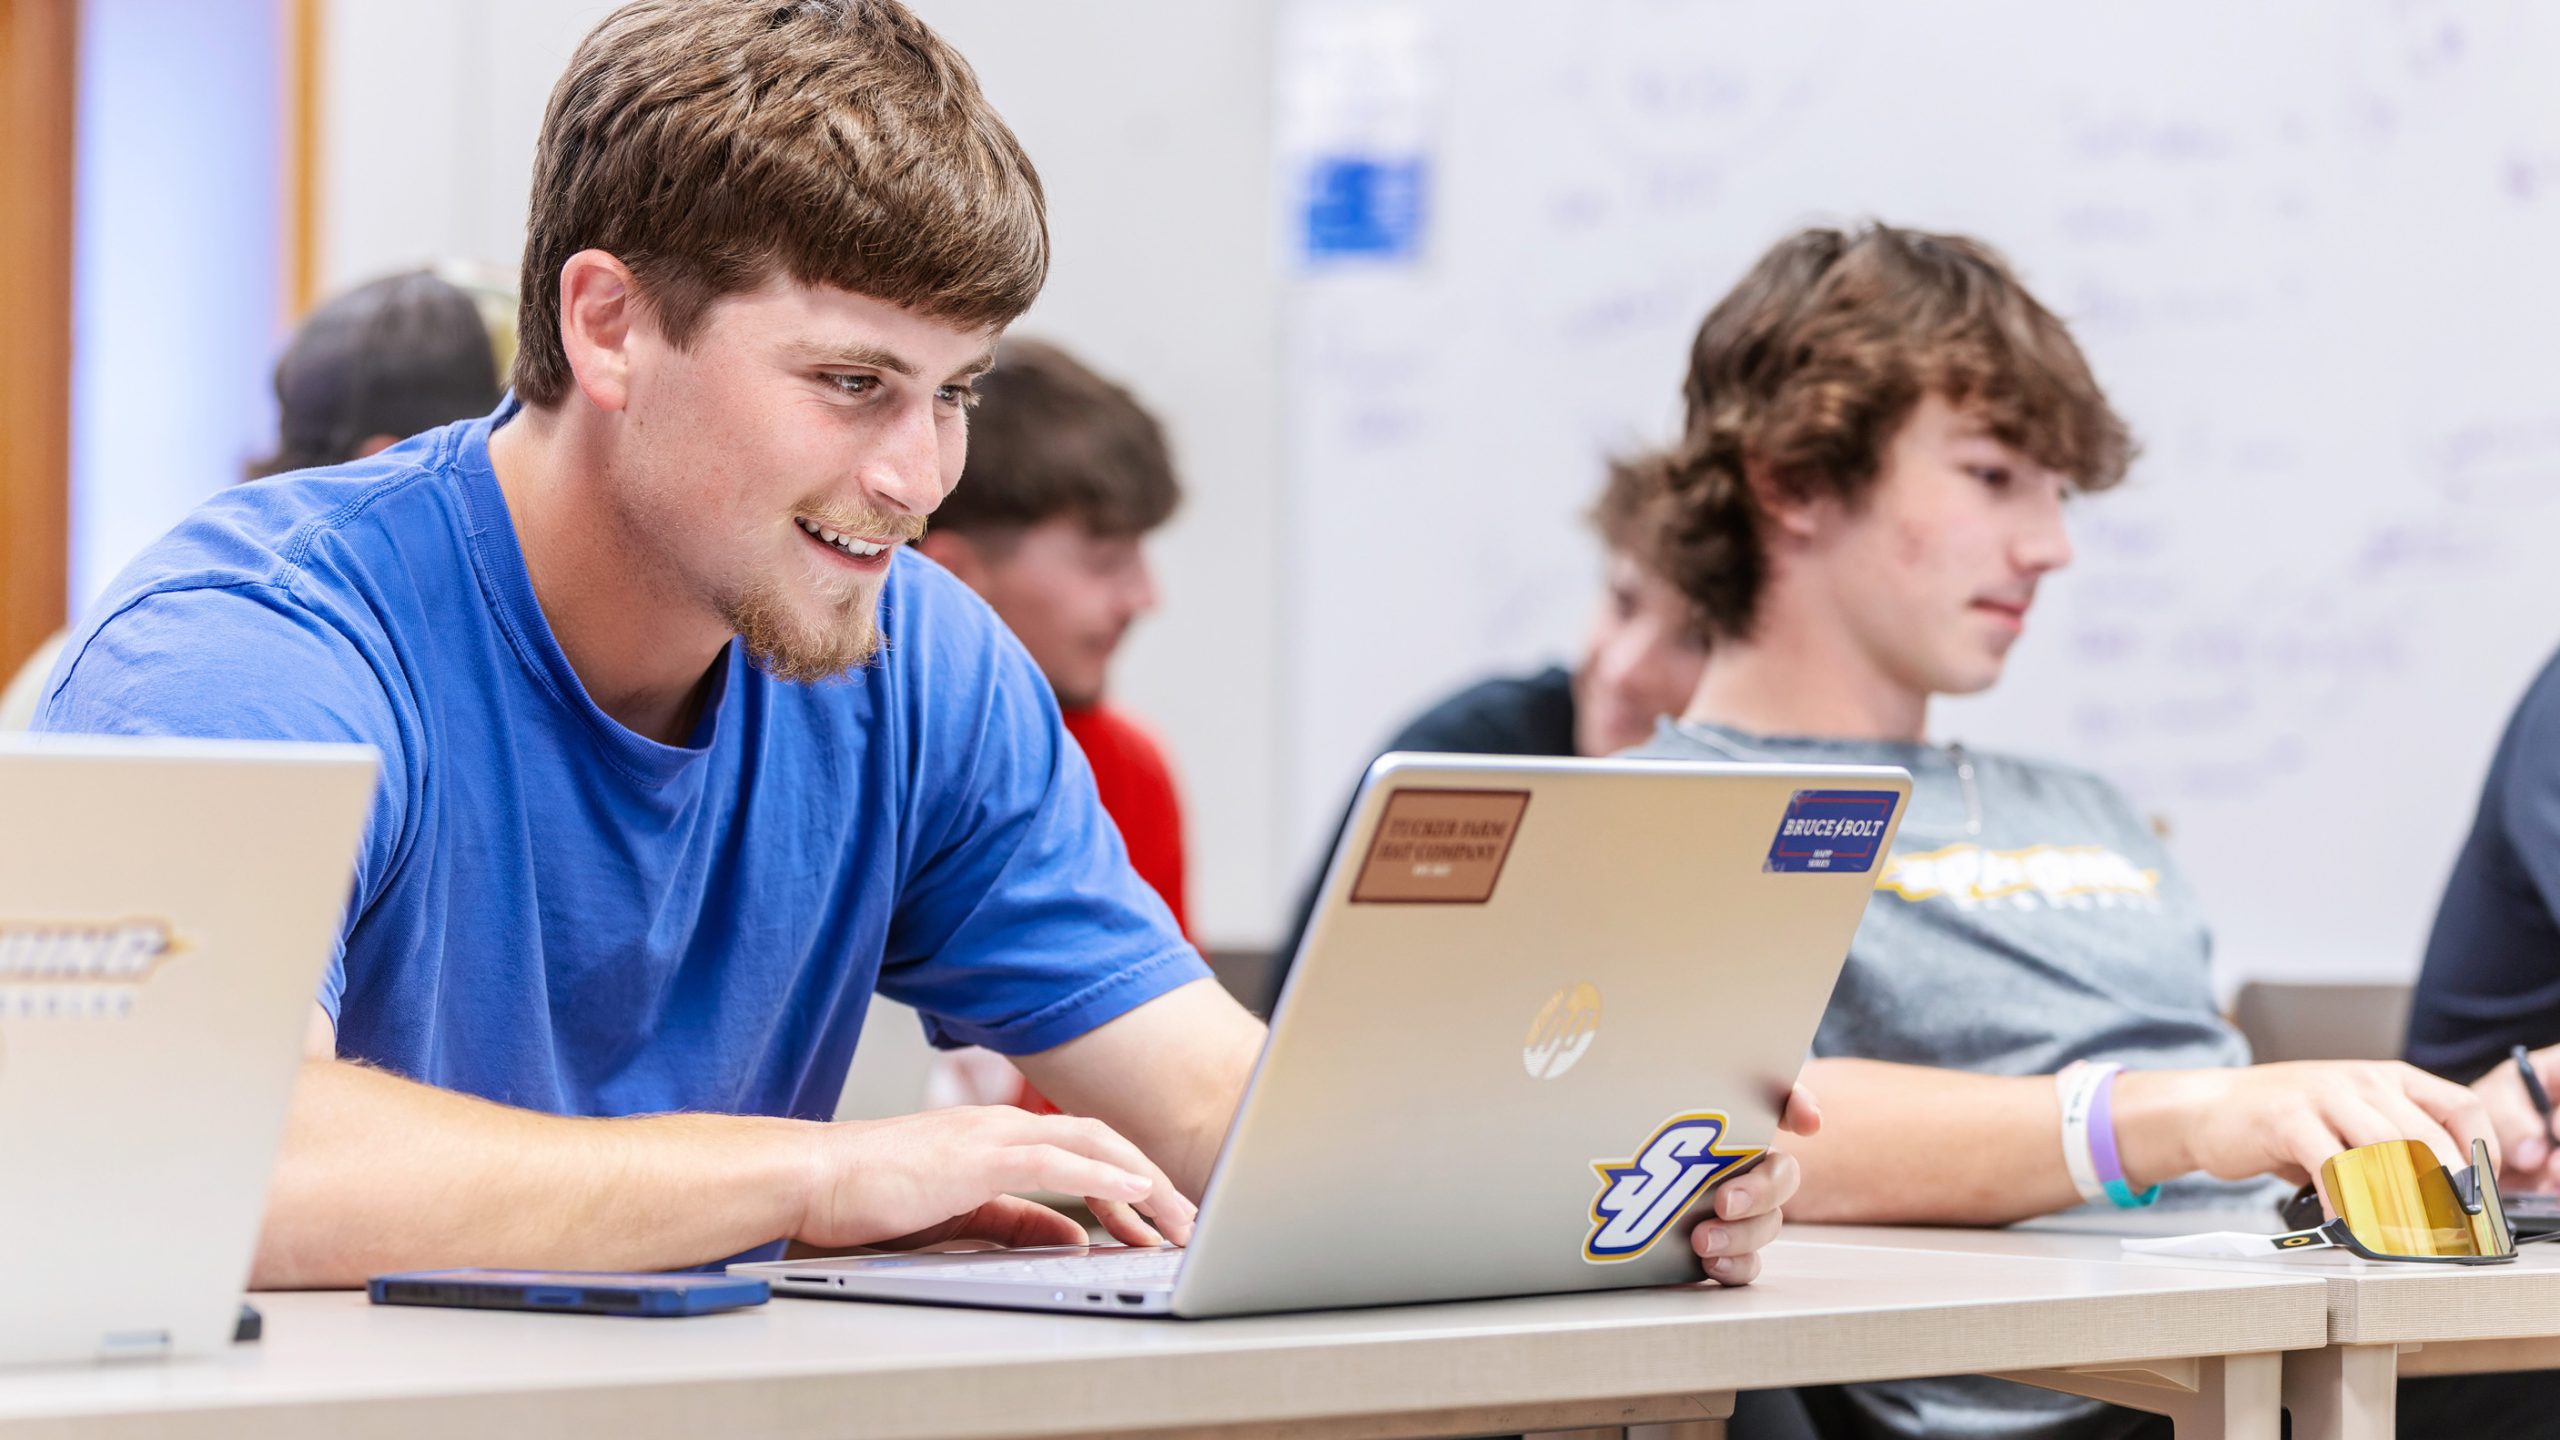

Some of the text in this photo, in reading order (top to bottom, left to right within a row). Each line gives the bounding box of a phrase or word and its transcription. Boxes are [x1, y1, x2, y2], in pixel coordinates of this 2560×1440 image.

[1782, 818, 1884, 836] BRUCE BOLT
[1413, 843, 1498, 862] COMPANY
